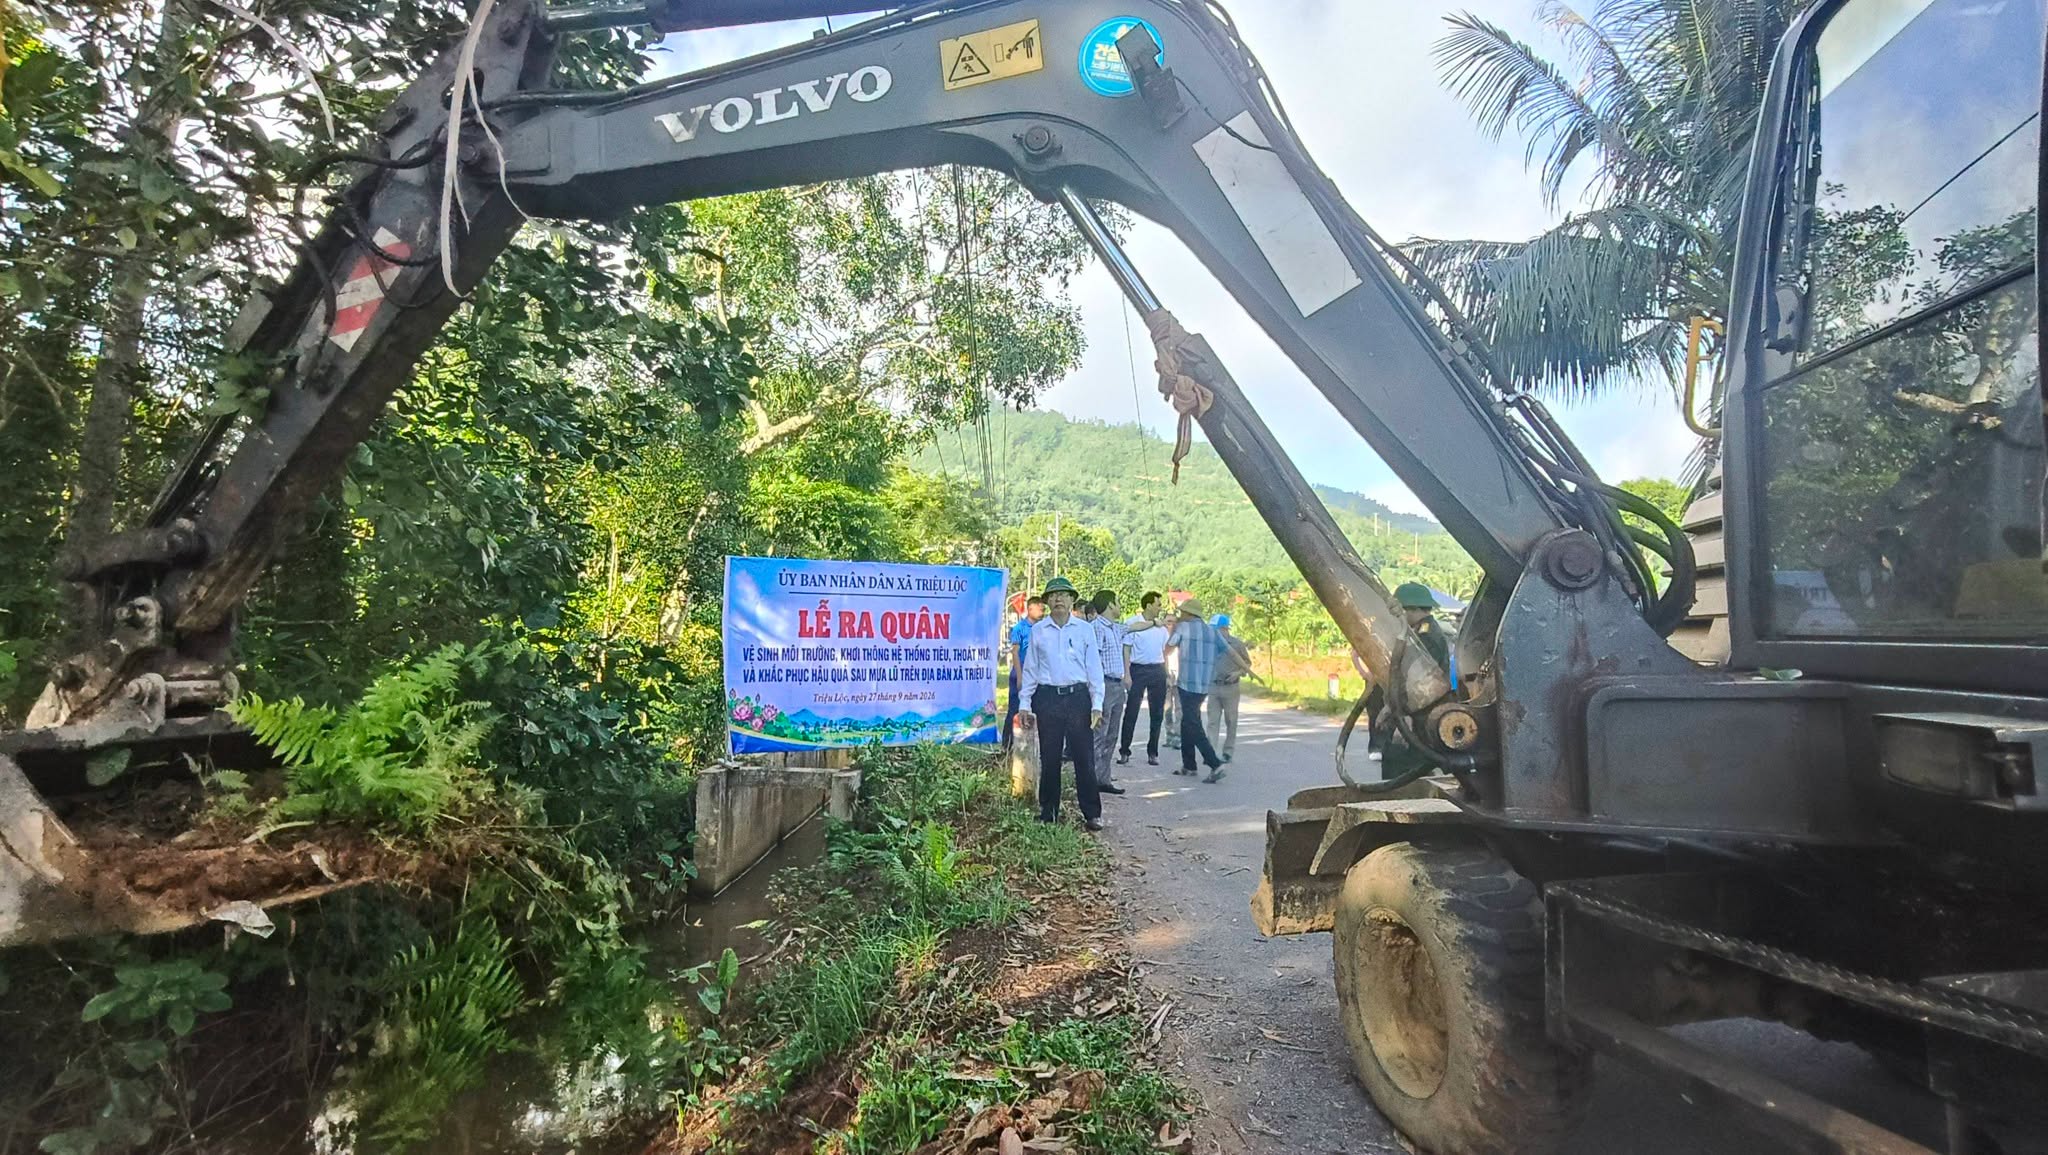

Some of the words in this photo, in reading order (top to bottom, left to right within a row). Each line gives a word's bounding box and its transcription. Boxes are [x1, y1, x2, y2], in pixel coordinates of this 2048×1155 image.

[654, 65, 893, 143] VOLVO
[779, 568, 797, 586] ỦY
[800, 574, 827, 587] BAN
[830, 572, 865, 588] NHÂN
[869, 572, 895, 589] DÂN
[897, 574, 912, 590] XÃ
[915, 576, 947, 595] TRIỆU
[948, 576, 967, 595] LỘC
[798, 599, 831, 638] LỄ
[838, 611, 874, 638] RA
[881, 606, 950, 644] QUÂN
[743, 644, 755, 664] VỆ
[757, 647, 779, 661] SINH
[782, 644, 799, 661] MÔI
[801, 644, 838, 662] TRƯỜNG,
[840, 647, 860, 661] KHƠI
[862, 645, 889, 661] THÔNG
[892, 645, 902, 664] HỆ
[904, 644, 930, 661] THỐNG
[933, 646, 951, 662] TIÊU,
[953, 645, 976, 661] THOÁT
[743, 666, 756, 683] VÀ
[758, 664, 783, 682] KHẮC
[786, 668, 809, 685] PHỤC
[811, 665, 828, 685] HẬU
[831, 665, 849, 683] QUẢ
[851, 668, 866, 682] SAU
[869, 667, 887, 682] MƯA
[889, 665, 898, 681] LŨ
[901, 665, 919, 681] TRÊN
[921, 668, 936, 684] ĐỊA
[936, 665, 952, 681] BÀN
[953, 665, 963, 681] XÃ
[965, 664, 984, 683] TRIỆU
[813, 693, 832, 704] Triệu
[851, 693, 867, 704] ngày
[869, 692, 877, 701] 27
[878, 692, 897, 702] tháng
[898, 692, 903, 700] 9
[904, 692, 918, 700] năm
